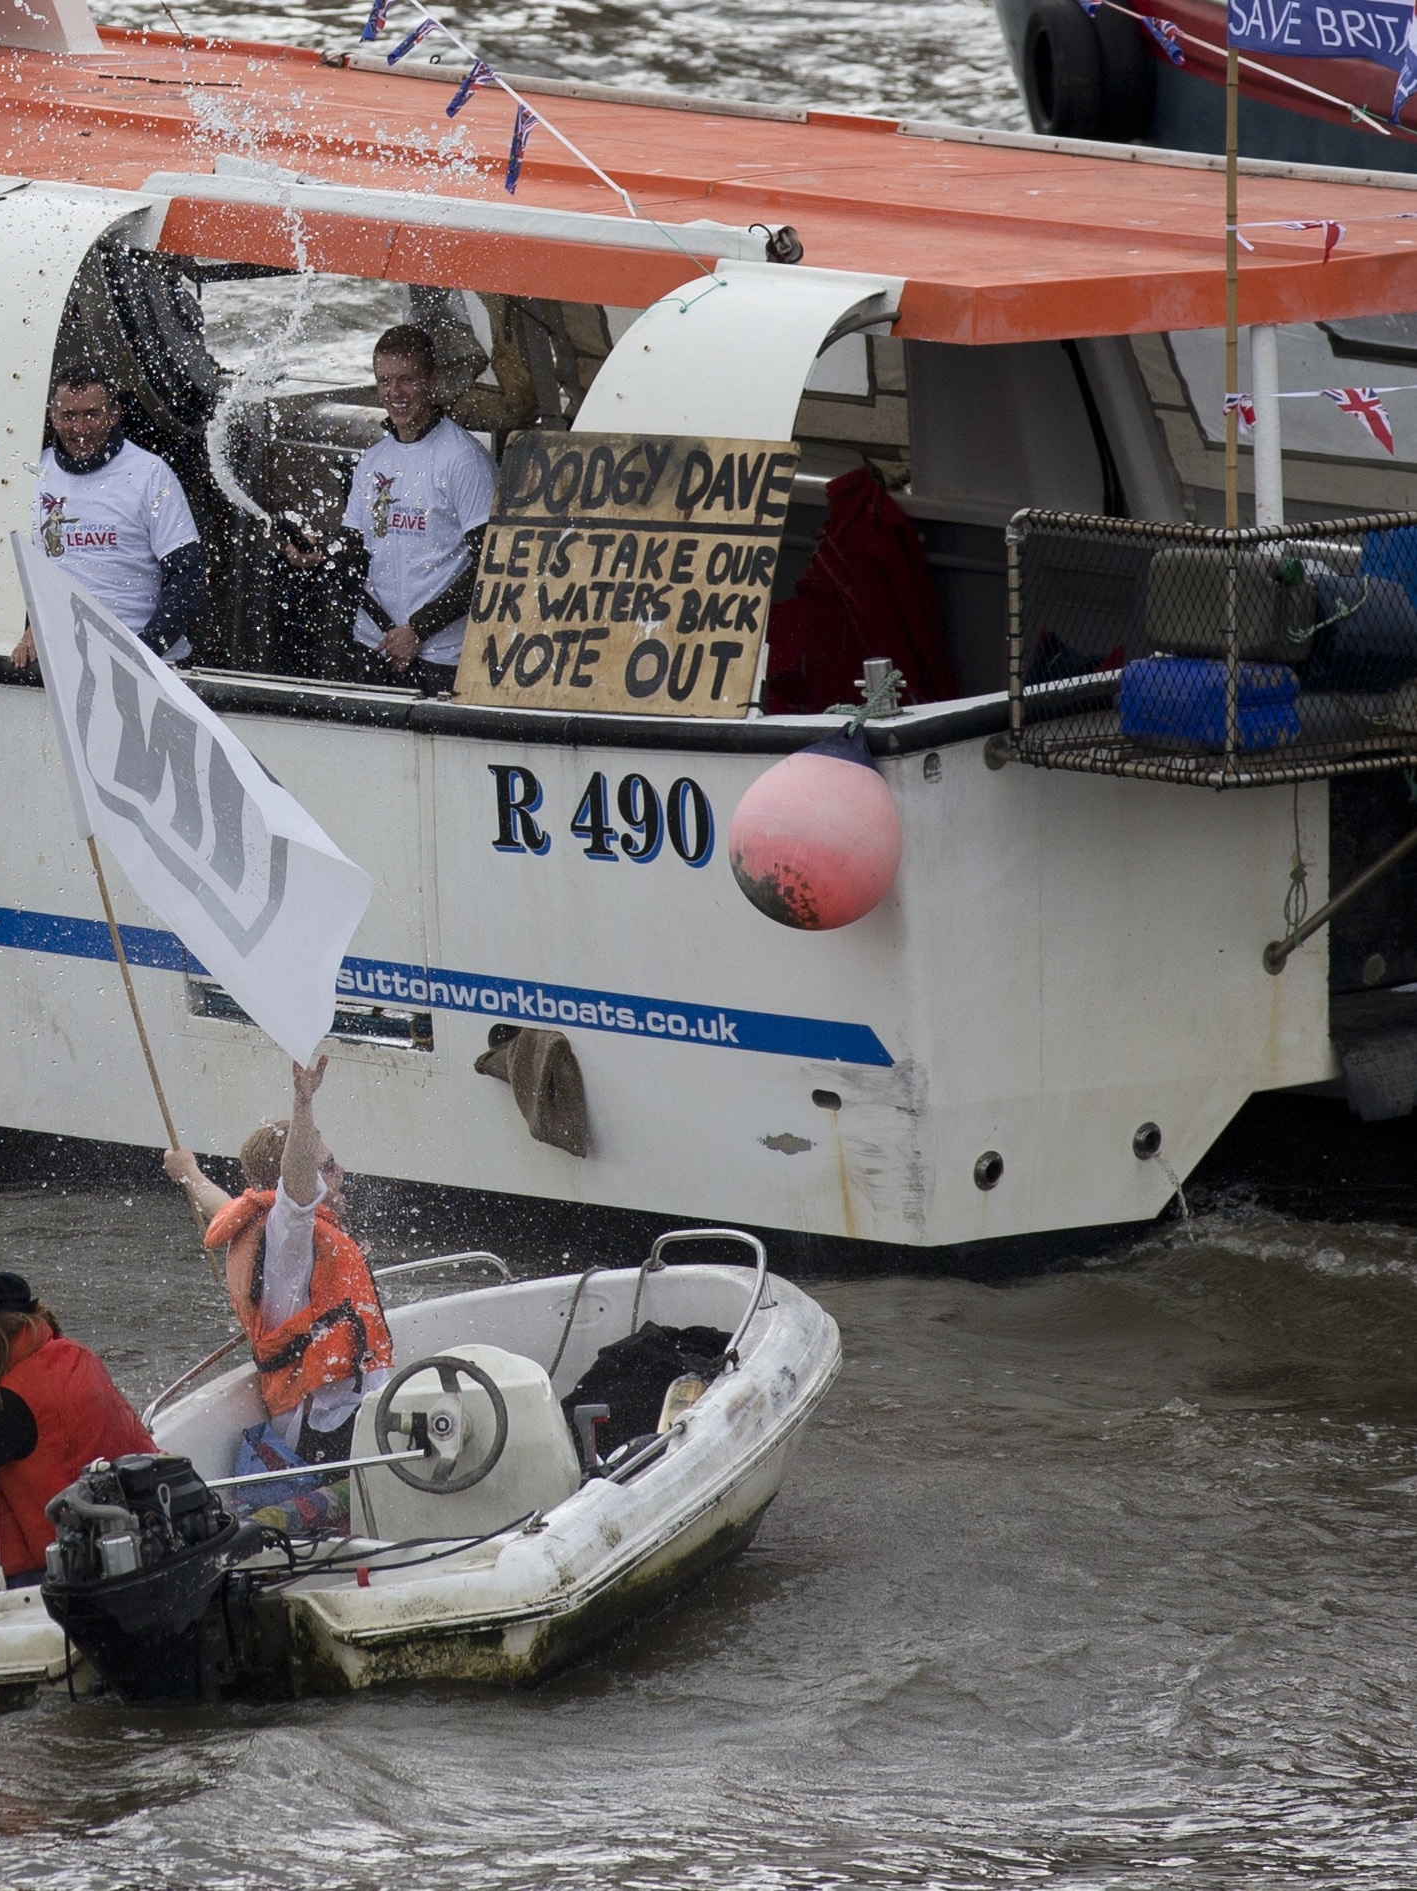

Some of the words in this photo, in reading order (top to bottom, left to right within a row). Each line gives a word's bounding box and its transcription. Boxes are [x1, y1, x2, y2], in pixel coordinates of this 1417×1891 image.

[1228, 0, 1301, 45] SAVE
[500, 443, 671, 515] DODGY
[674, 448, 795, 518] DAVE
[66, 532, 118, 546] LEAVE
[587, 533, 699, 584] TAKE
[705, 542, 778, 588] OUR
[471, 581, 526, 623] UK
[537, 581, 674, 623] WATERS
[677, 588, 762, 634] BACK
[486, 627, 610, 688] VOTE
[624, 638, 744, 702] OUT
[487, 764, 552, 856] R
[570, 771, 715, 868] 490
[336, 967, 740, 1045] suttonworkboats.co.uk
